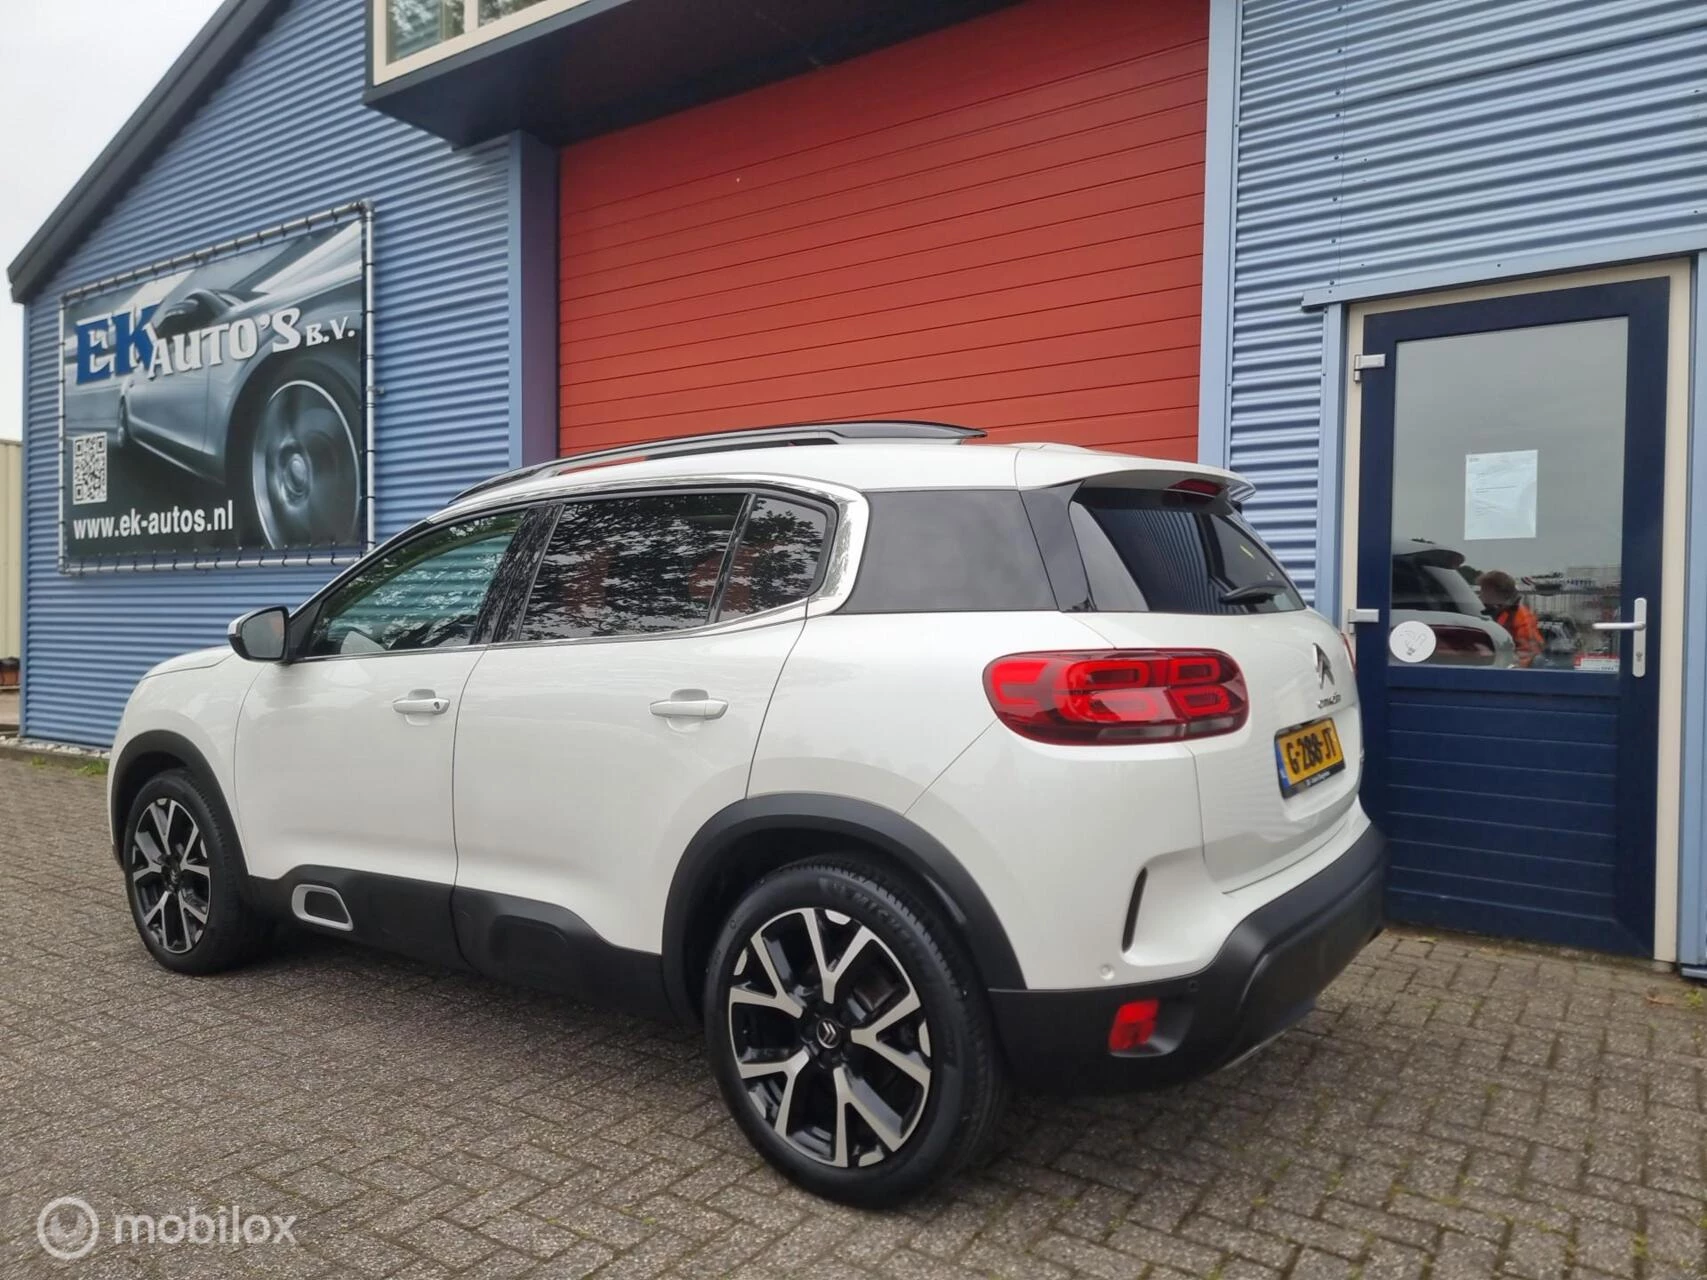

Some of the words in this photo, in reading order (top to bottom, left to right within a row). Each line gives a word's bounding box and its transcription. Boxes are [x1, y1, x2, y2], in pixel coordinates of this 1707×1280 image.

[76, 303, 160, 384] EK
[306, 316, 355, 347] B.V.
[73, 499, 233, 540] www.ek-autos.nl
